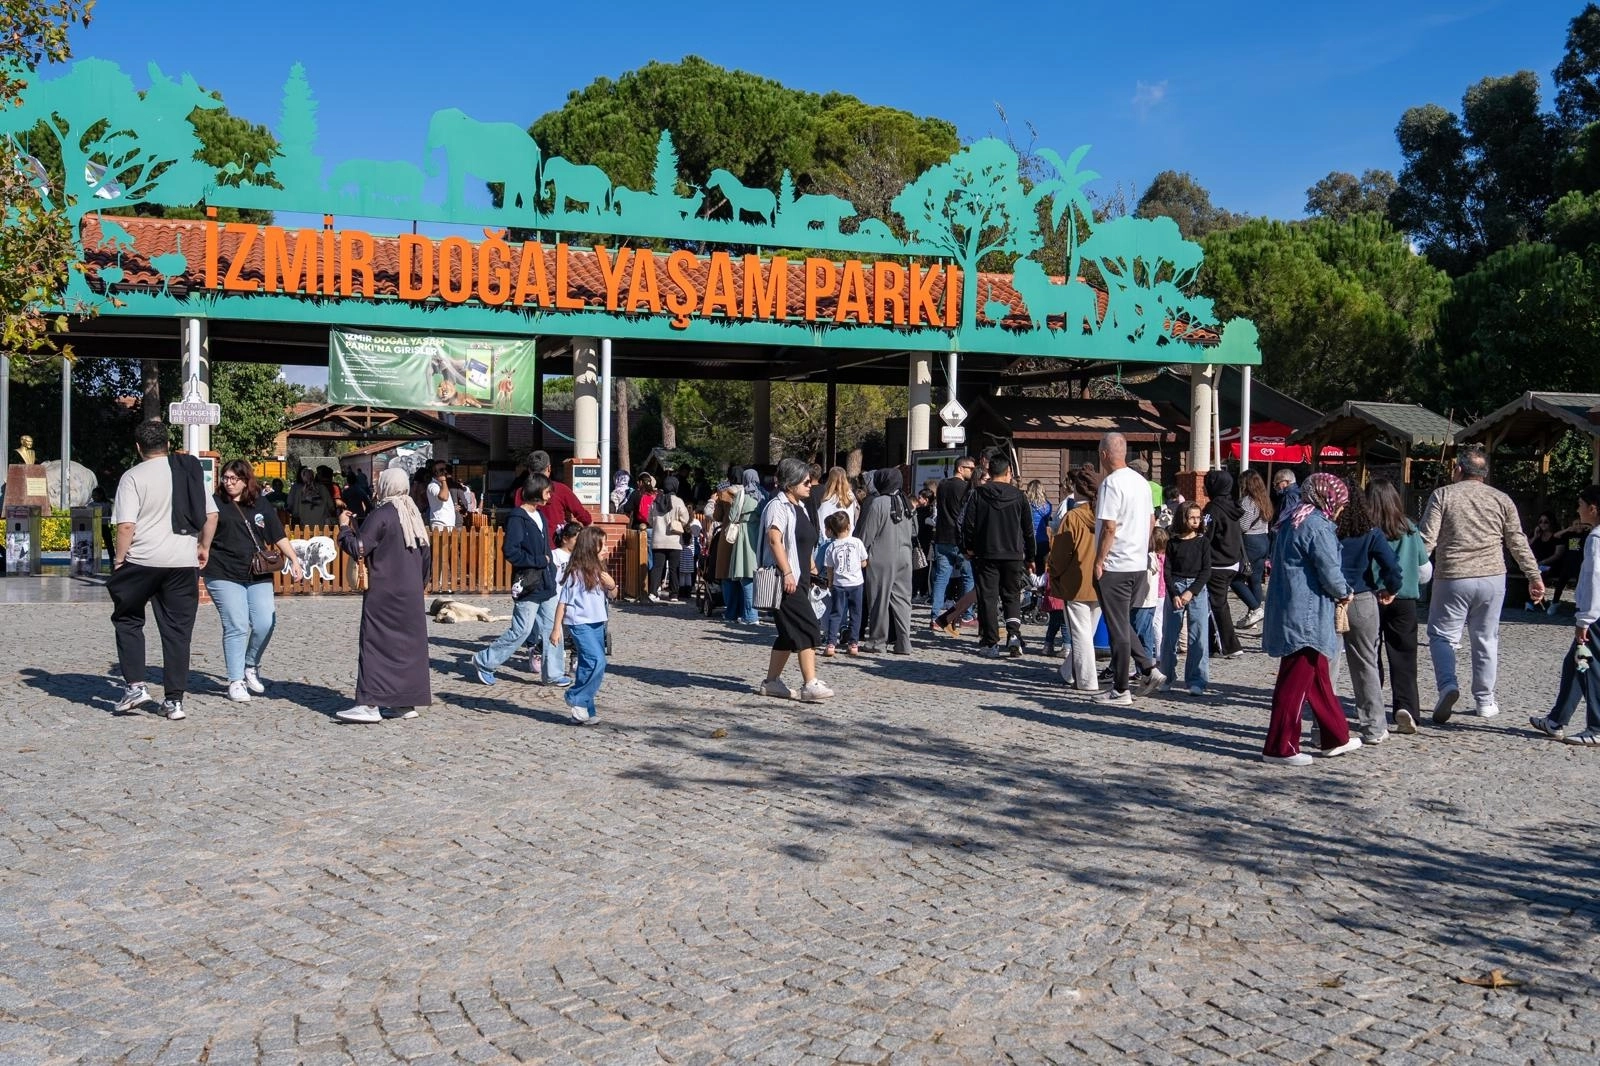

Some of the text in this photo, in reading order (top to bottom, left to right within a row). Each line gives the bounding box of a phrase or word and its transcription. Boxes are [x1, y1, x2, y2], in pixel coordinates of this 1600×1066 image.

[205, 207, 957, 328] İZMİR DOĞAL YAŞAM PARKI
